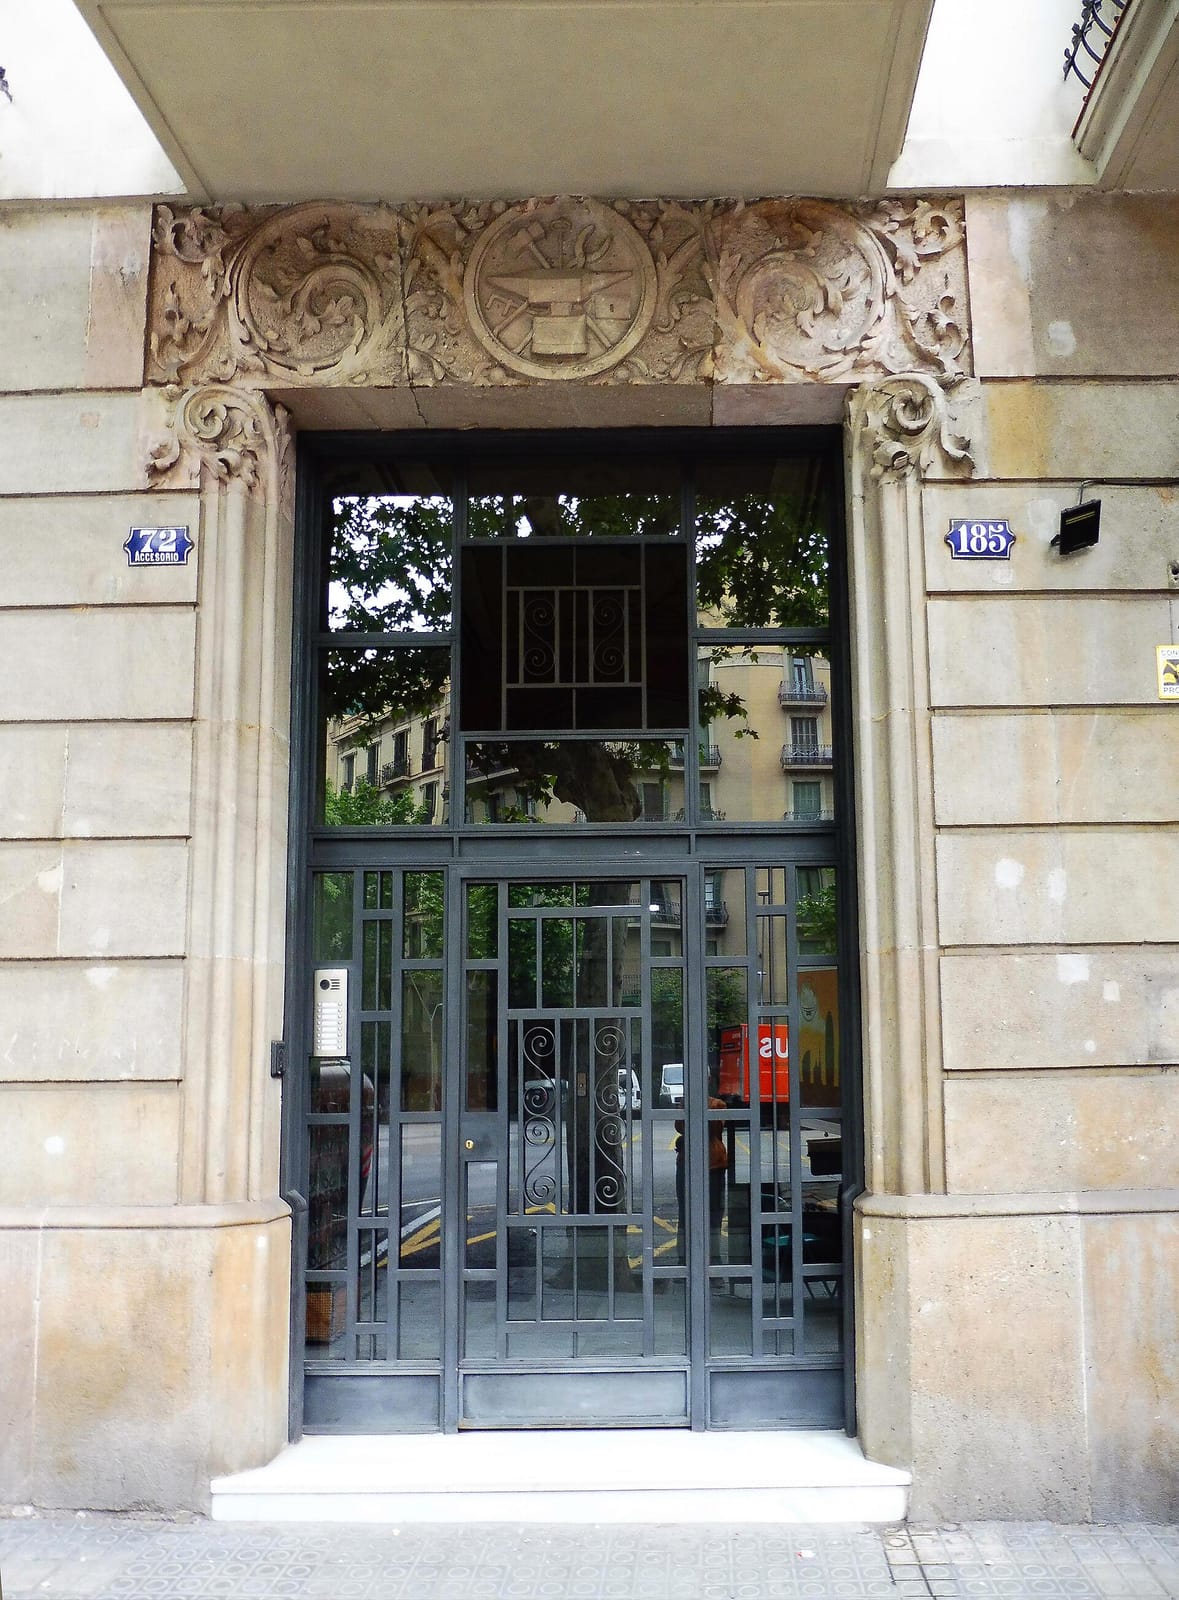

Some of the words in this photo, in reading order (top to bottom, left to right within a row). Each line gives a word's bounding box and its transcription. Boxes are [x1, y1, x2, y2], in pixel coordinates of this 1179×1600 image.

[139, 529, 177, 553] 72
[957, 524, 1007, 553] 185
[134, 550, 179, 562] ACCESORIO
